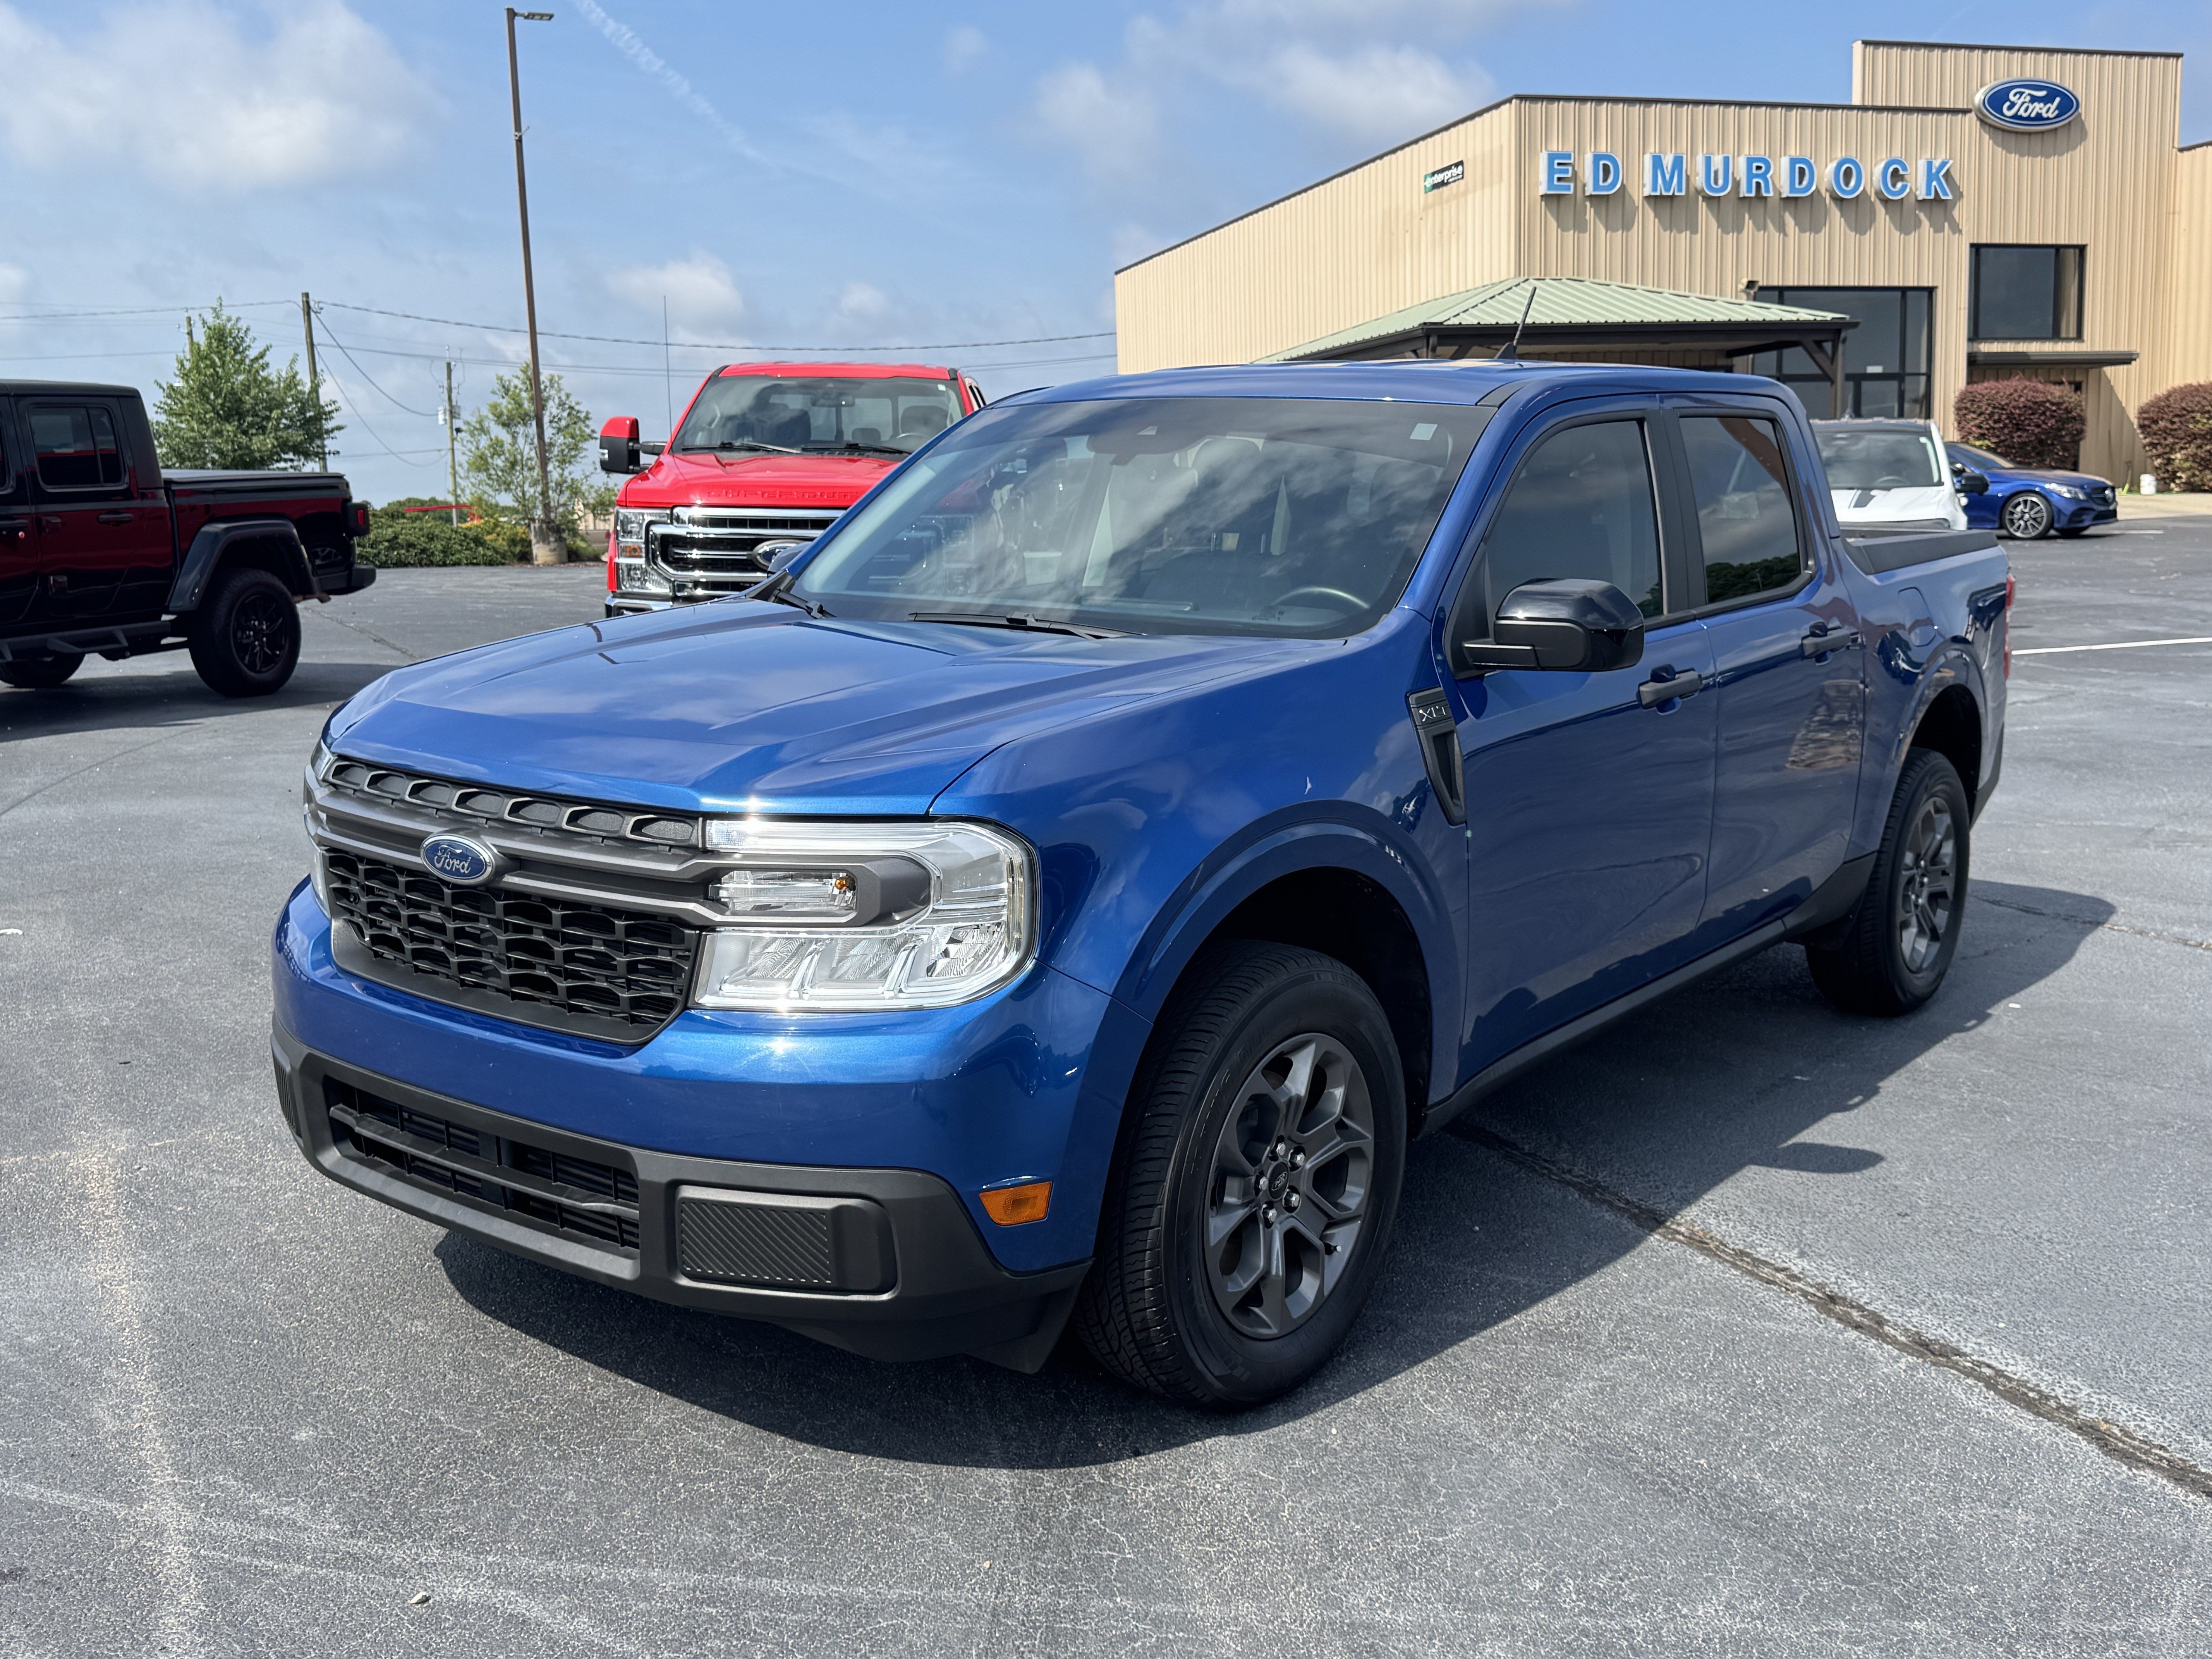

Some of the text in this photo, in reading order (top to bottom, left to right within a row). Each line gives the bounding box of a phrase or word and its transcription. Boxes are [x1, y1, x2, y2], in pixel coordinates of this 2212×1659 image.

[2002, 88, 2061, 118] Ford
[1540, 151, 1953, 200] ED MURDOCK
[434, 845, 471, 874] Ford
